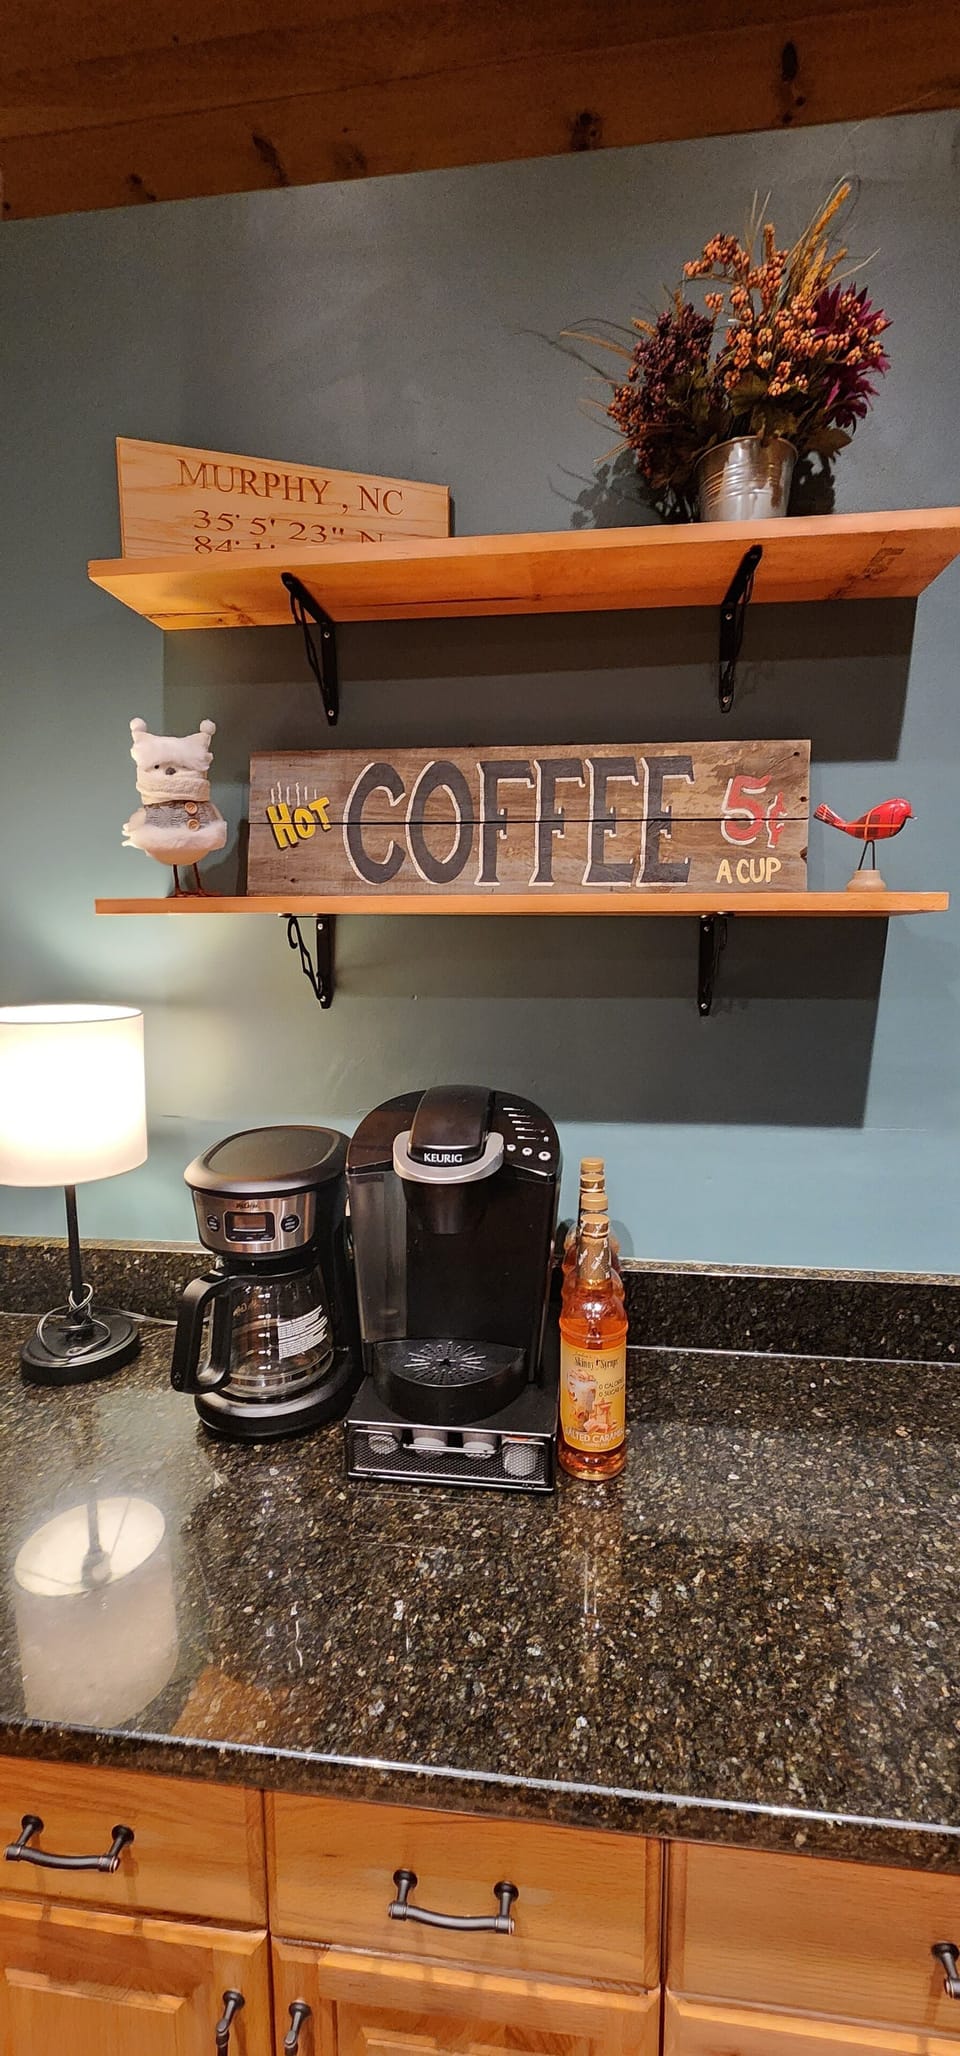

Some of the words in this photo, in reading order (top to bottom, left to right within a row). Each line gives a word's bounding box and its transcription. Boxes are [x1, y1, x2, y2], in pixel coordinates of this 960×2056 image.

[177, 458, 331, 505] MURPHY
[357, 485, 404, 516] NC
[343, 754, 696, 887] COFFEE
[715, 859, 733, 884] A
[735, 856, 782, 885] CUP
[423, 1152, 463, 1164] KEURIG
